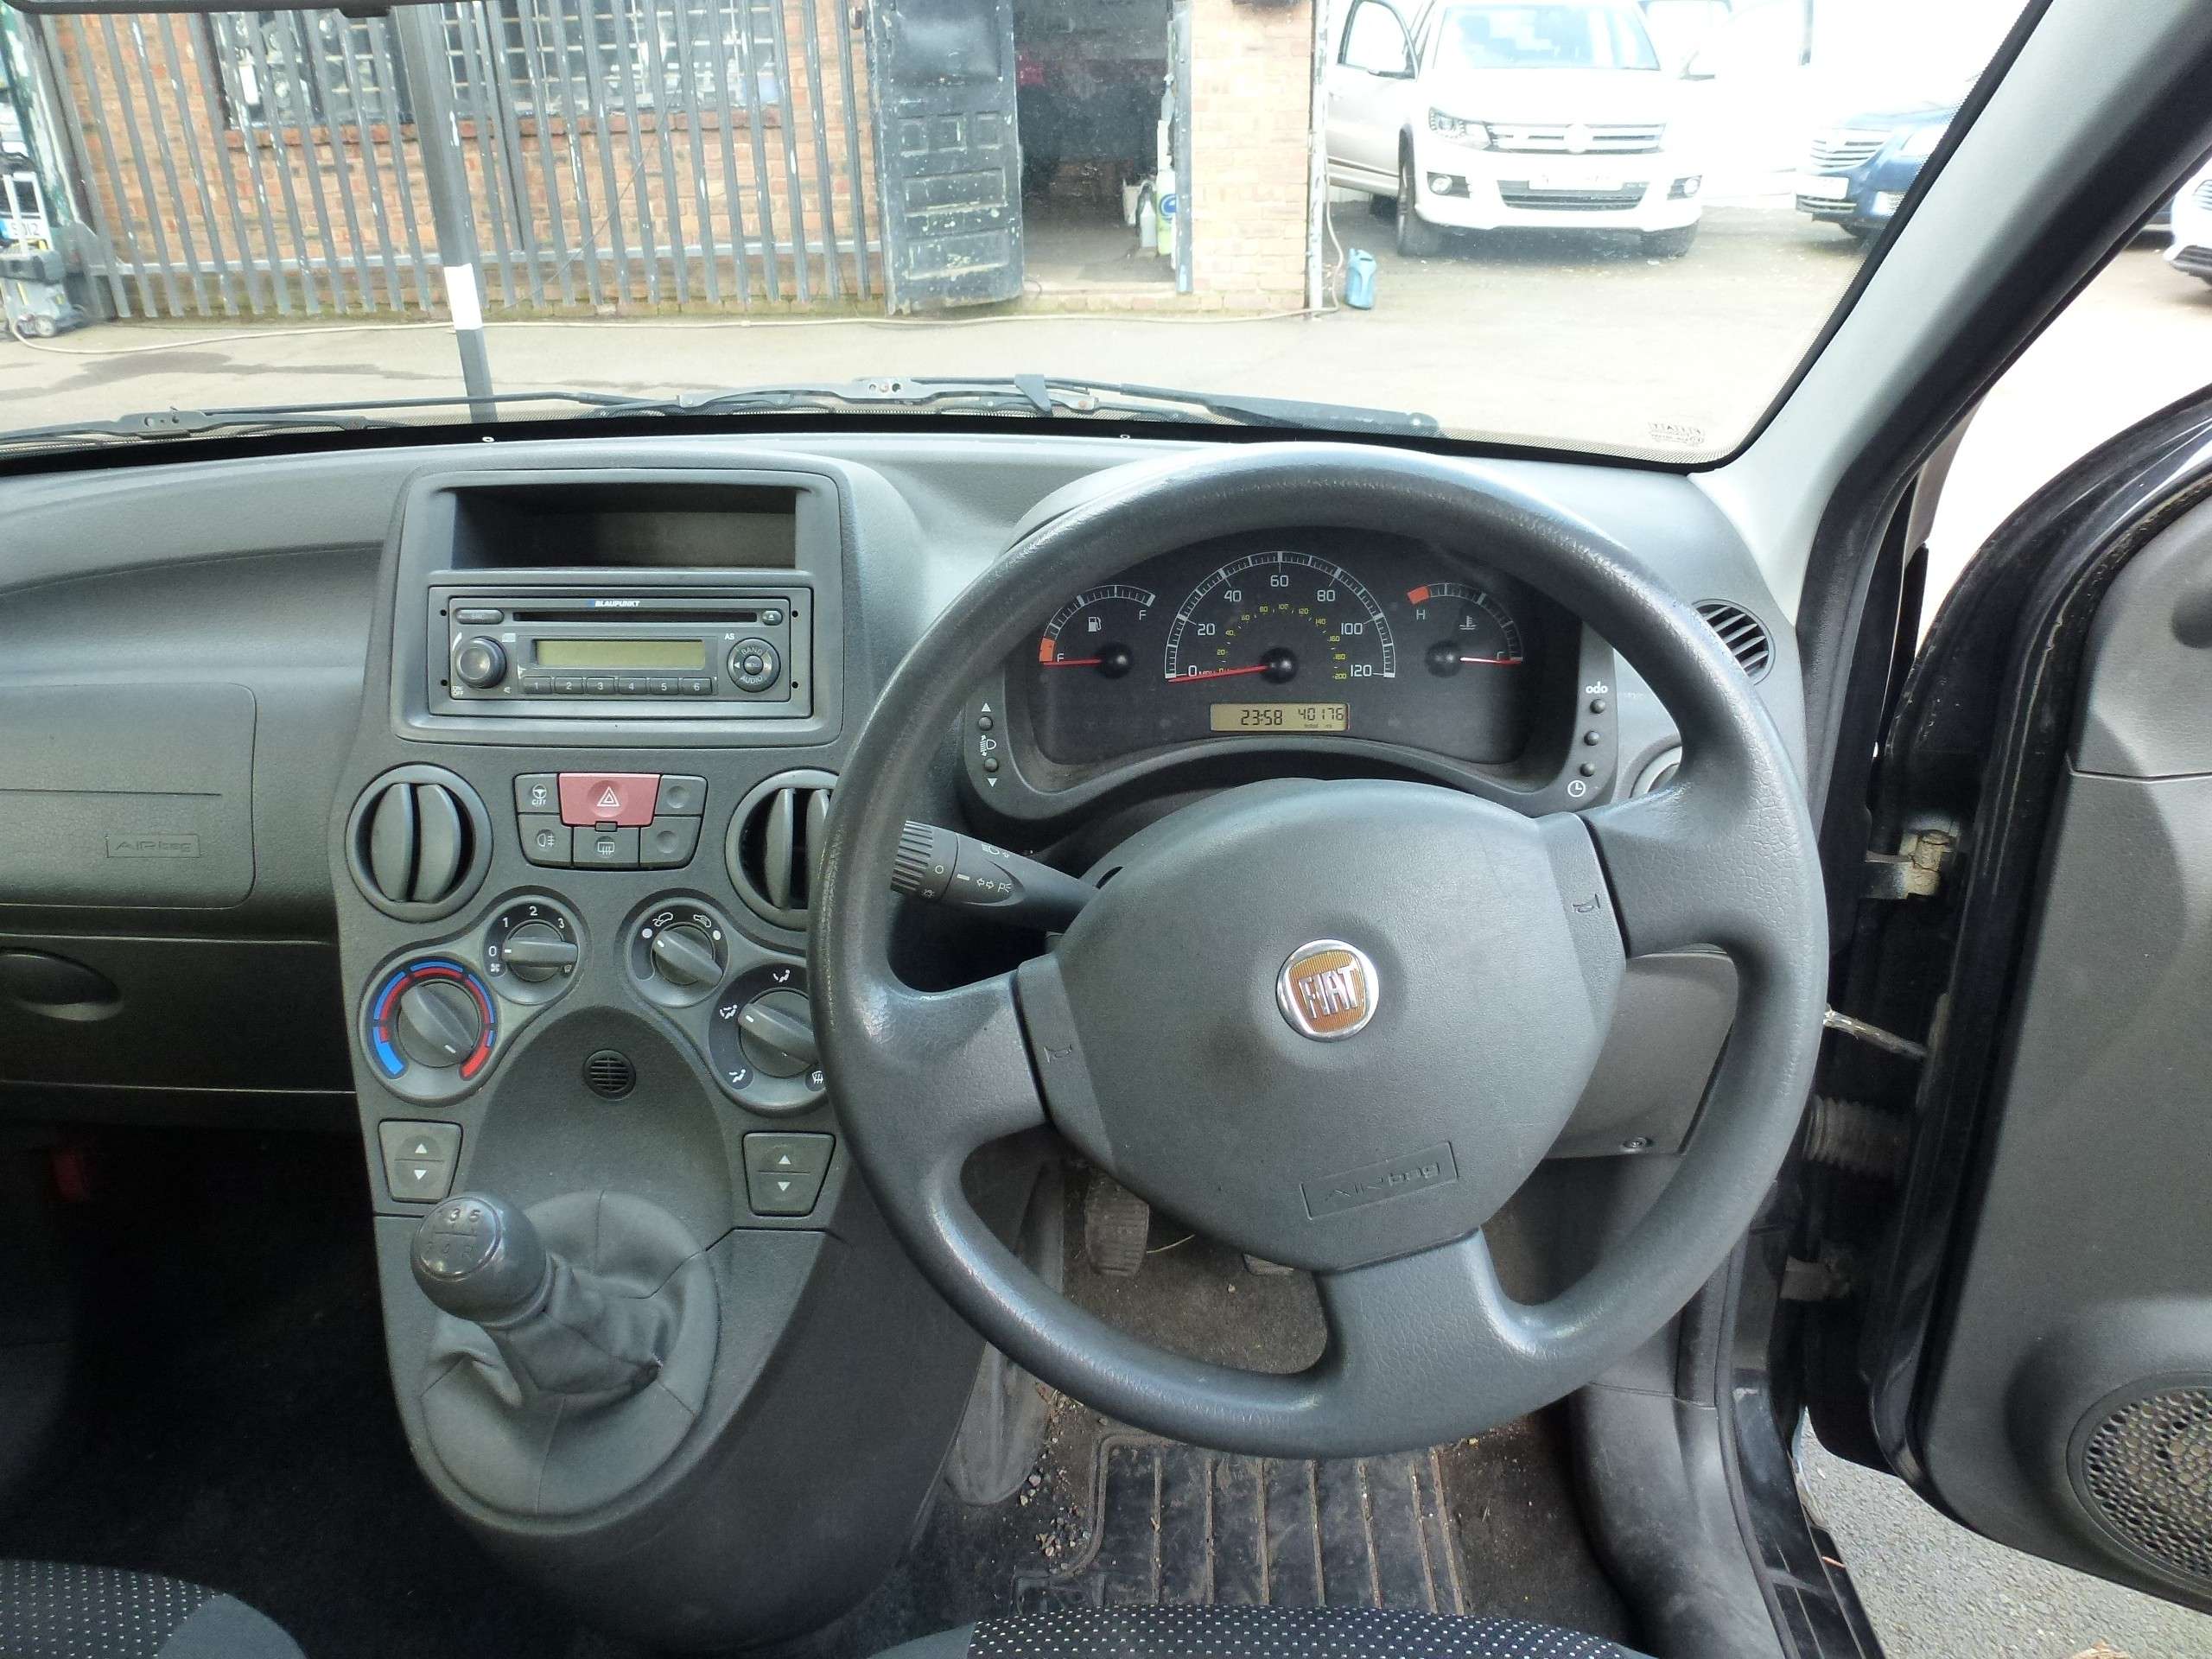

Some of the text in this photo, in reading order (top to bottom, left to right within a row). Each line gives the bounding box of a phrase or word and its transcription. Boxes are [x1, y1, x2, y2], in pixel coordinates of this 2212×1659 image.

[1270, 575, 1289, 588] 60
[1224, 589, 1242, 602] 40
[1317, 589, 1336, 602] 80
[1139, 609, 1147, 620] F
[1416, 609, 1426, 620] H
[1197, 623, 1216, 636] 20
[1341, 622, 1363, 635] 100
[741, 646, 763, 657] BAND
[1188, 664, 1198, 677] 0
[1350, 664, 1372, 677] 120
[740, 676, 763, 684] AUDIO
[534, 682, 539, 690] 1
[566, 682, 572, 690] 2
[597, 682, 604, 690] 3
[628, 682, 634, 690] 4
[661, 683, 667, 691] 5
[694, 683, 700, 691] 6
[1585, 681, 1608, 694] odo
[1241, 707, 1344, 726] 23:58 40176
[529, 906, 538, 916] 2
[502, 917, 509, 928] 1
[557, 918, 565, 929] 3
[1298, 963, 1358, 1020] FIAT
[469, 1209, 481, 1223] 5
